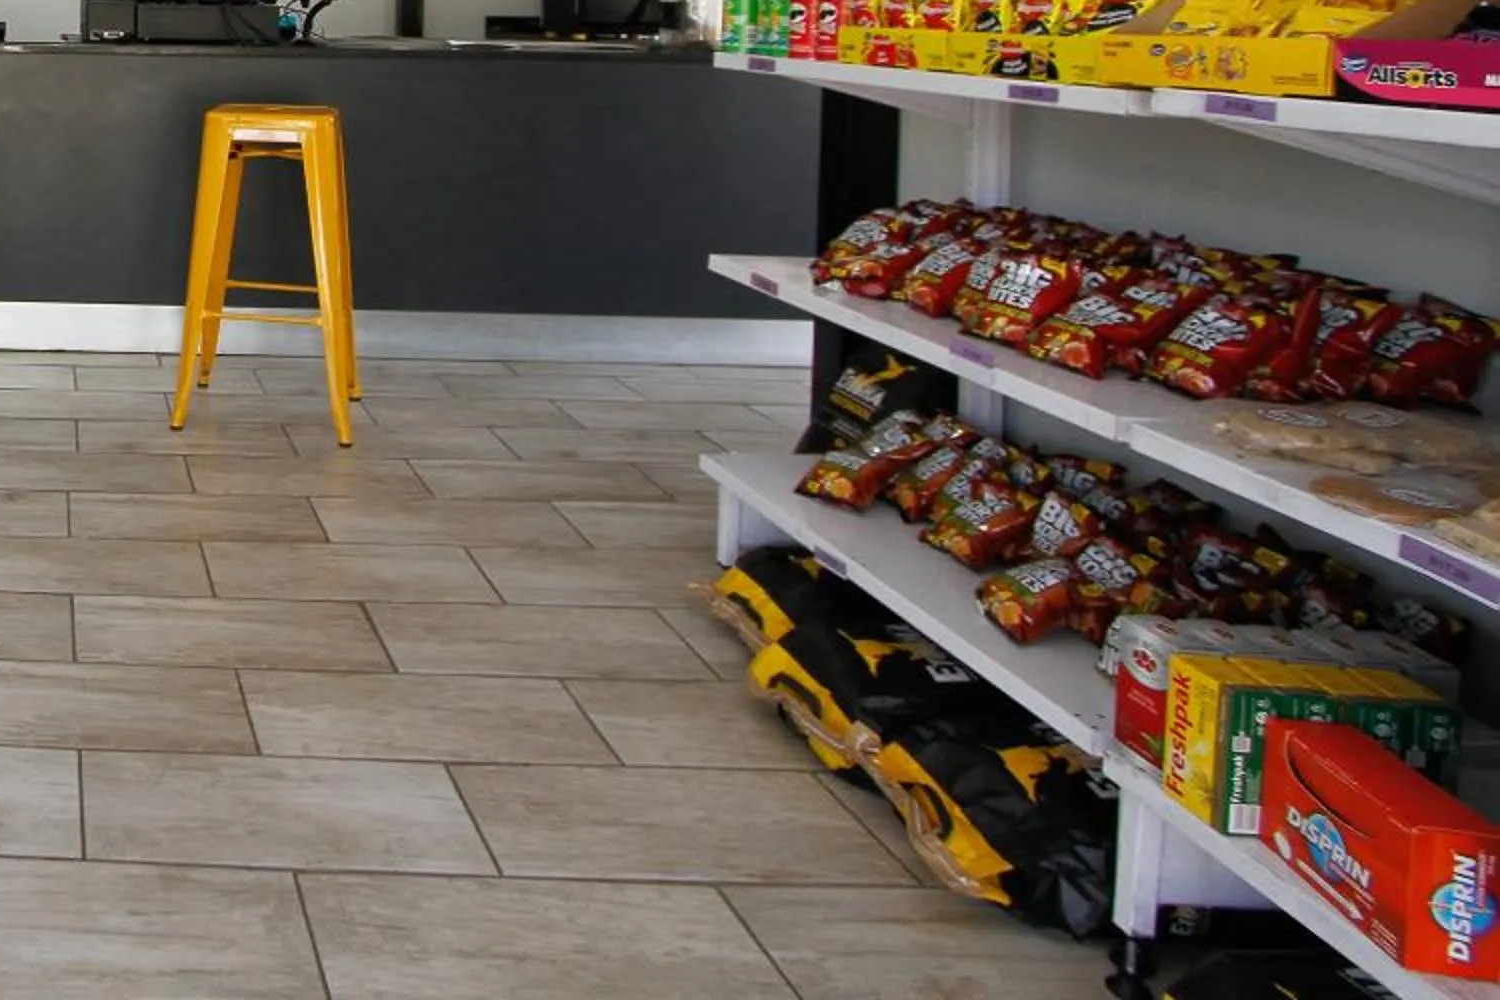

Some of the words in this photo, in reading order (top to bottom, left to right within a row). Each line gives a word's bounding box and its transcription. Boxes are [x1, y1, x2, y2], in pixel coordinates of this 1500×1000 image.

[1366, 64, 1457, 89] Allsorts
[1164, 672, 1193, 797] Freshpak
[1285, 804, 1373, 891] DISPRIN
[1446, 852, 1477, 963] DISPRIN
